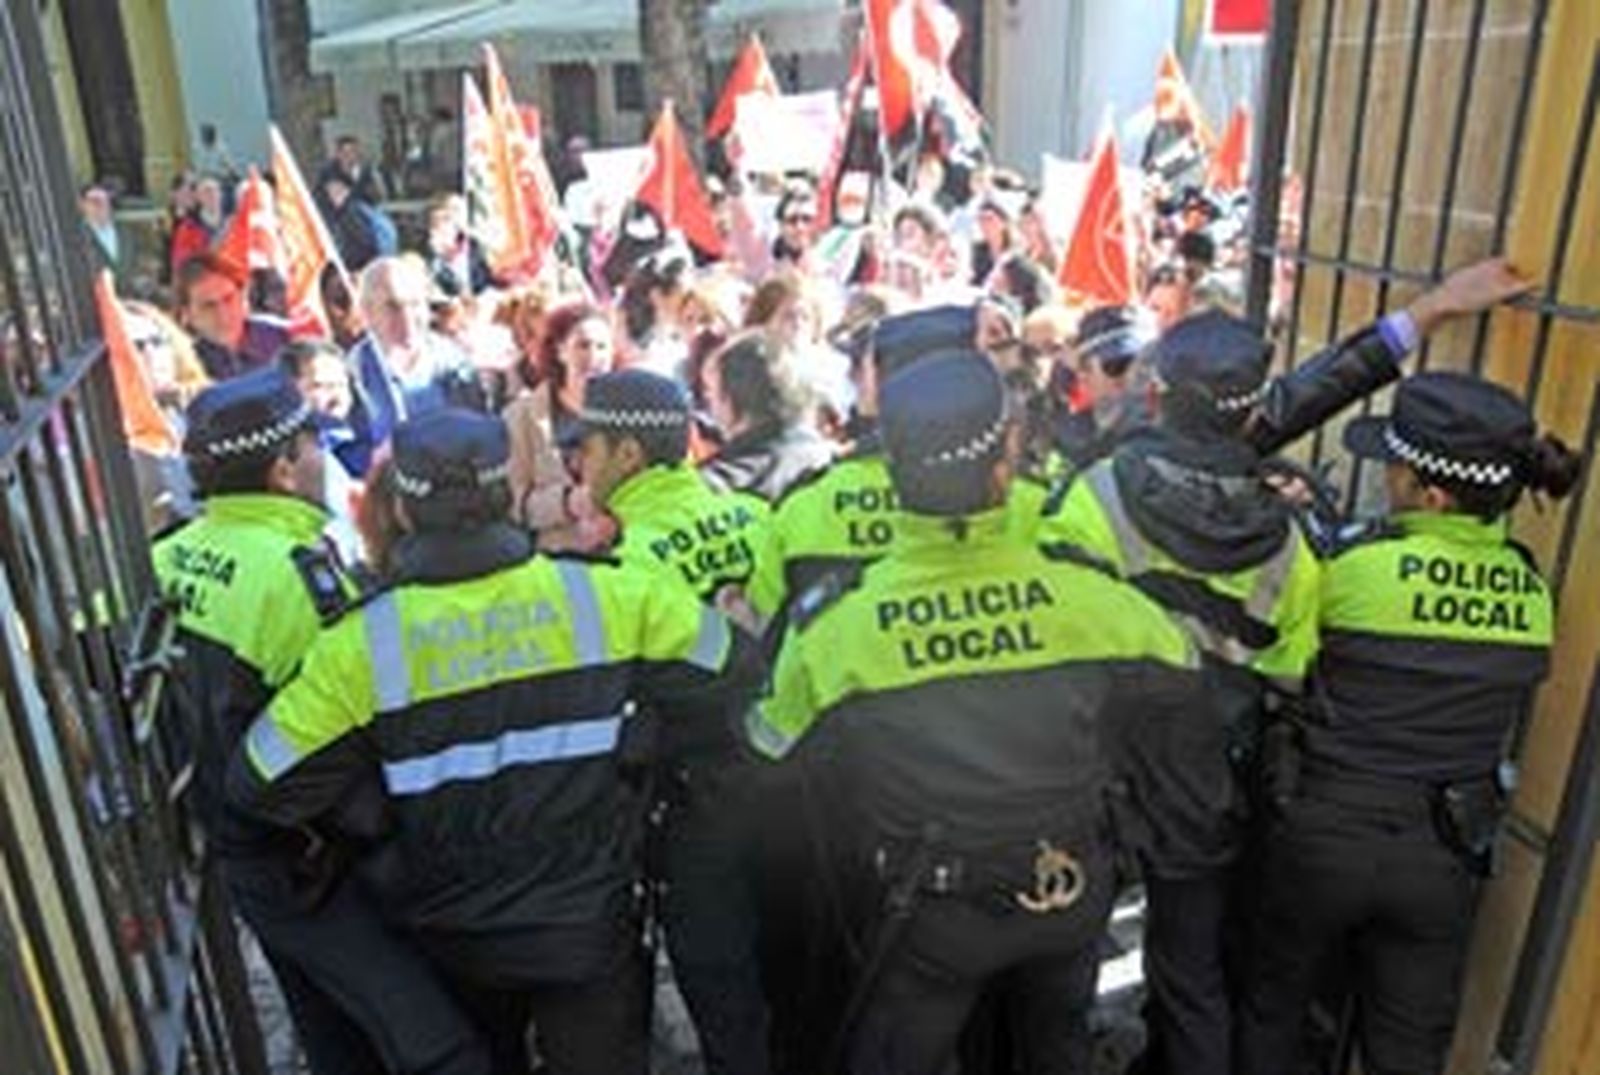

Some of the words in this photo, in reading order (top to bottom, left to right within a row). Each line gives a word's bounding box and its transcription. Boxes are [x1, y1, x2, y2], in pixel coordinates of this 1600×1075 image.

[877, 578, 1055, 631] POLICIA
[1413, 592, 1530, 632] LOCAL
[902, 621, 1045, 670] LOCAL
